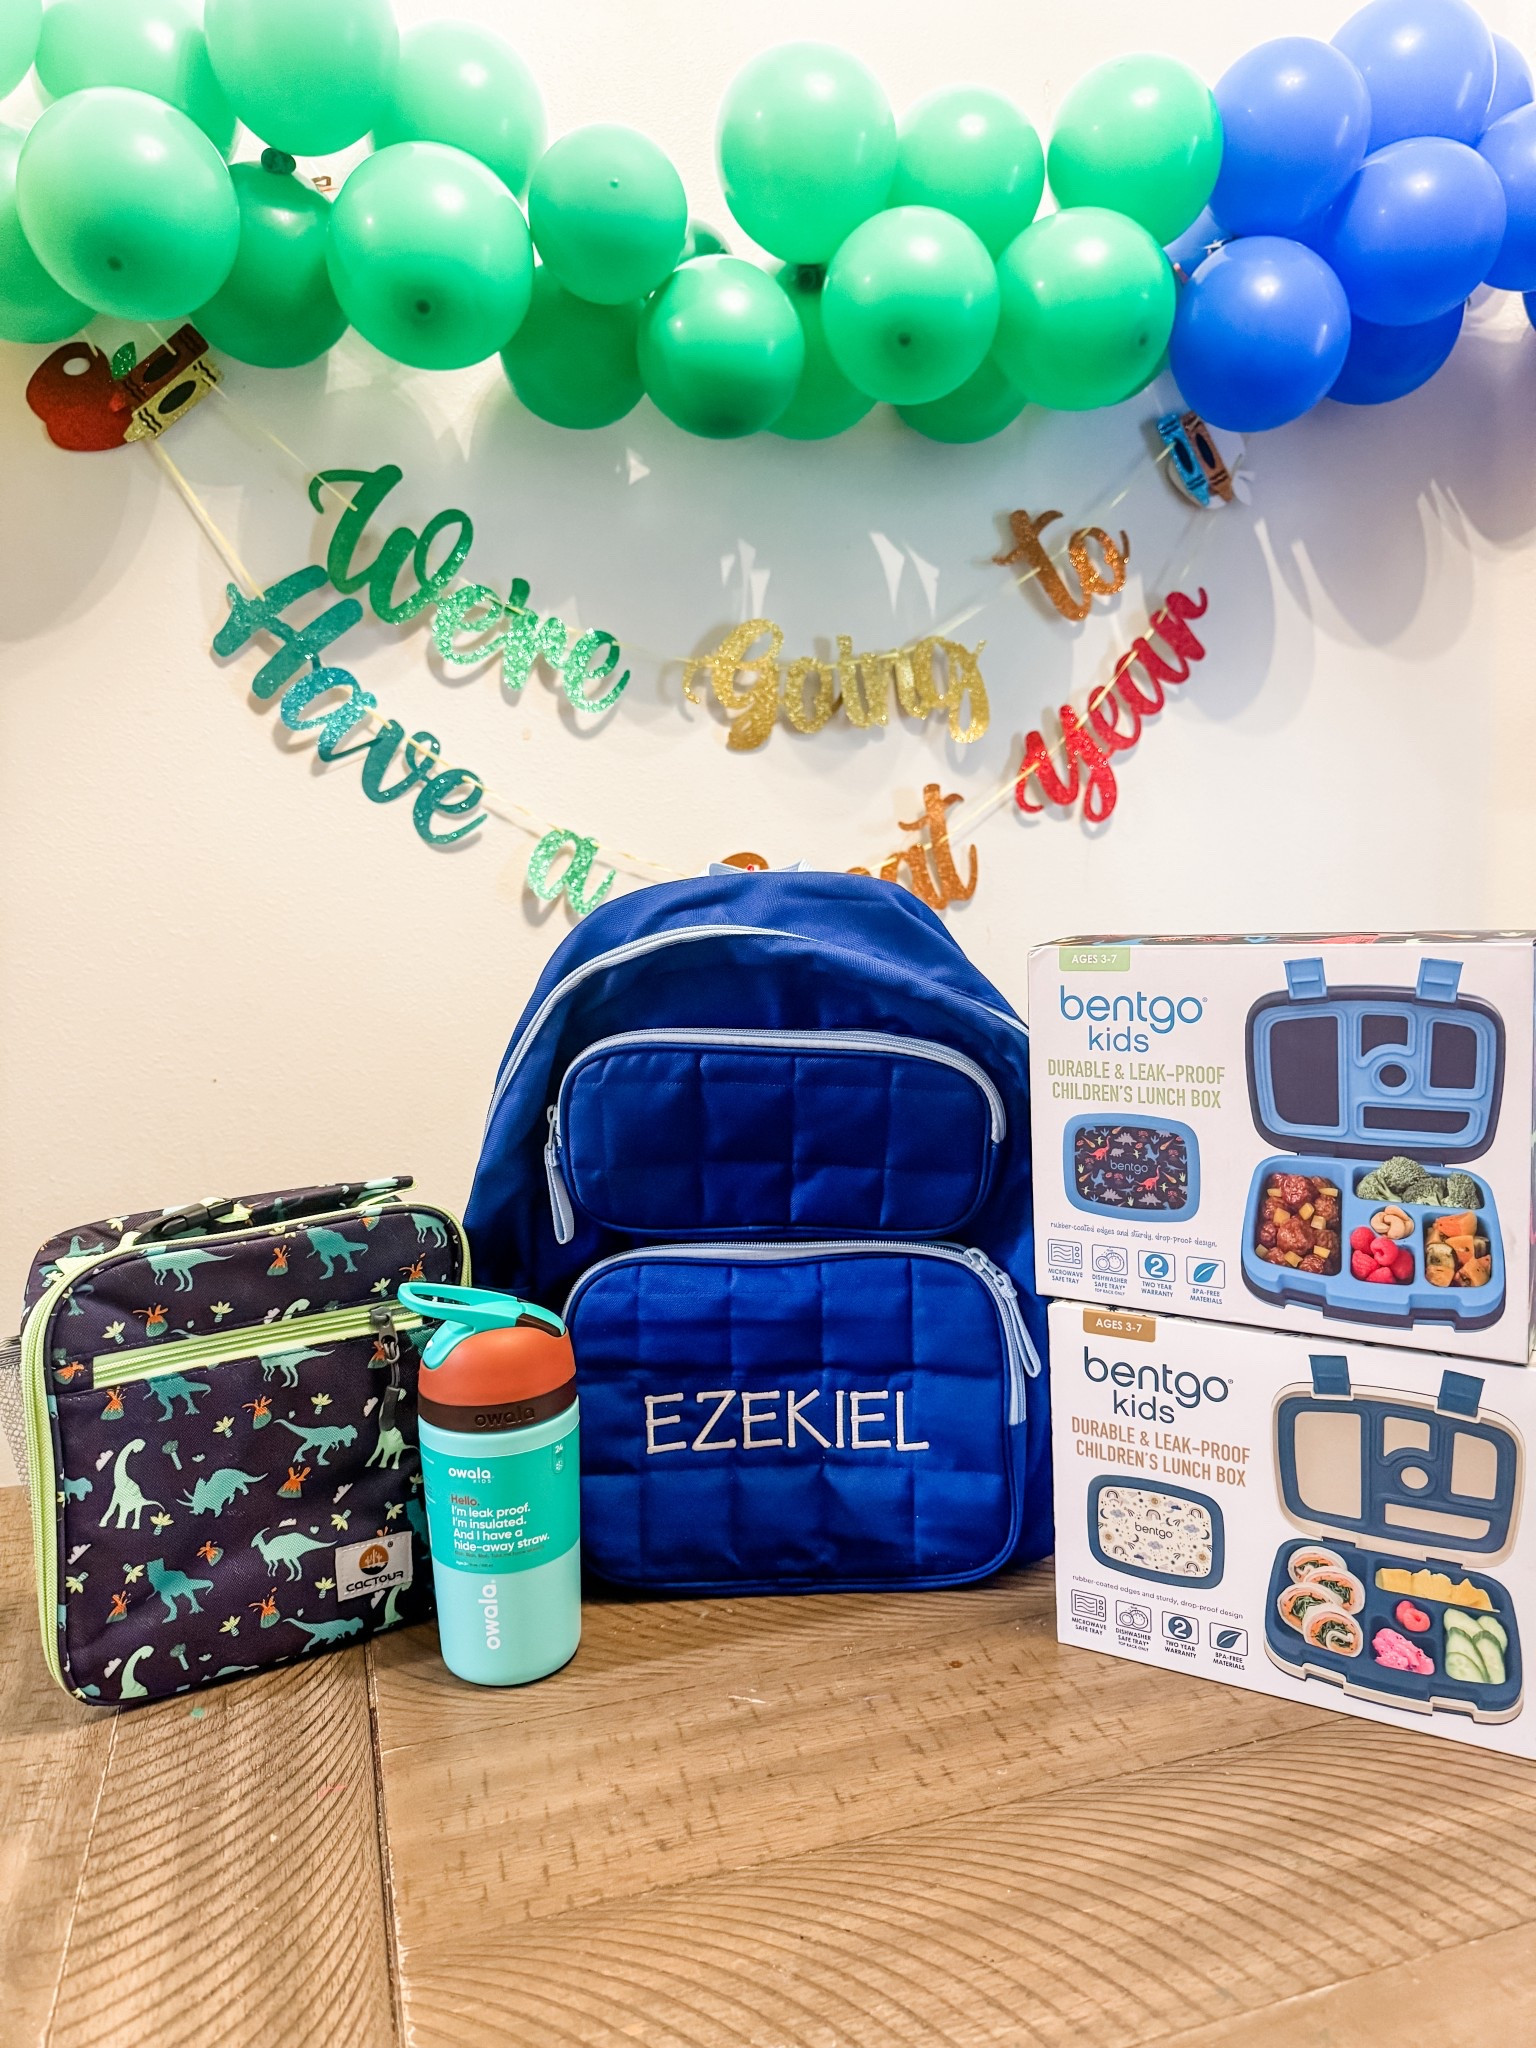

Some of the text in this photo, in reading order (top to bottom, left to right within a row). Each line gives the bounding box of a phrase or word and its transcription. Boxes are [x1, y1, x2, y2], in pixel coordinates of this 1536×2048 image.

[682, 618, 990, 751] Going
[993, 510, 1129, 621] to
[1015, 586, 1208, 823] year
[213, 564, 616, 915] Have a
[1071, 954, 1117, 964] AGES 3-7
[1060, 985, 1203, 1034] bentgo
[1088, 1025, 1149, 1053] kids
[1048, 1059, 1225, 1085] DURABLE & LEAK-PROOF
[1052, 1082, 1222, 1109] CHILDREN'S LUNCH BOX
[1110, 1160, 1149, 1175] bentgo
[1050, 1222, 1094, 1233] rubber-coated
[1097, 1227, 1114, 1236] edges
[1117, 1229, 1129, 1237] and
[1155, 1233, 1192, 1244] drop-proof
[1048, 1268, 1083, 1278] MICROWAVE
[1150, 1257, 1164, 1276] 2
[1092, 1274, 1127, 1284] DISHWASHER
[1157, 1282, 1172, 1290] YEAR
[1141, 1288, 1173, 1297] WARRANTY
[1190, 1295, 1222, 1305] MATERIALS
[1192, 1288, 1220, 1297] BPA-FREE
[1095, 1318, 1142, 1333] AGES 3-7
[1084, 1346, 1229, 1409] bentgo
[1113, 1389, 1175, 1424] kids
[475, 1406, 535, 1428] owala
[645, 1389, 929, 1454] EZEKIEL
[1071, 1416, 1250, 1465] DURABLE & LEAK-PROOF
[1076, 1439, 1246, 1487] CHILDREN'S LUNCH BOX
[448, 1467, 491, 1479] owala
[451, 1494, 480, 1506] Hello.
[451, 1502, 531, 1519] I'm leak proof.
[452, 1515, 527, 1530] I'm insulated.
[1134, 1522, 1173, 1540] bentgo
[453, 1528, 474, 1540] And
[482, 1530, 512, 1541] have
[514, 1529, 523, 1537] a
[453, 1539, 515, 1553] hide-away
[517, 1533, 550, 1549] straw.
[346, 1570, 404, 1592] CACTOUR
[1072, 1575, 1244, 1620] rubber-coated edges and sturdy, drop-proof design
[477, 1583, 501, 1650] owala
[1071, 1617, 1107, 1630] MICROWAVE
[1075, 1624, 1088, 1632] SAFE
[1115, 1628, 1151, 1641] DISHWASHER
[1174, 1619, 1187, 1638] 2
[1164, 1646, 1197, 1659] WARRANTY
[1166, 1640, 1195, 1652] TWO YEAR
[1212, 1658, 1245, 1671] MATERIALS
[1215, 1652, 1243, 1663] BPA-FREE
